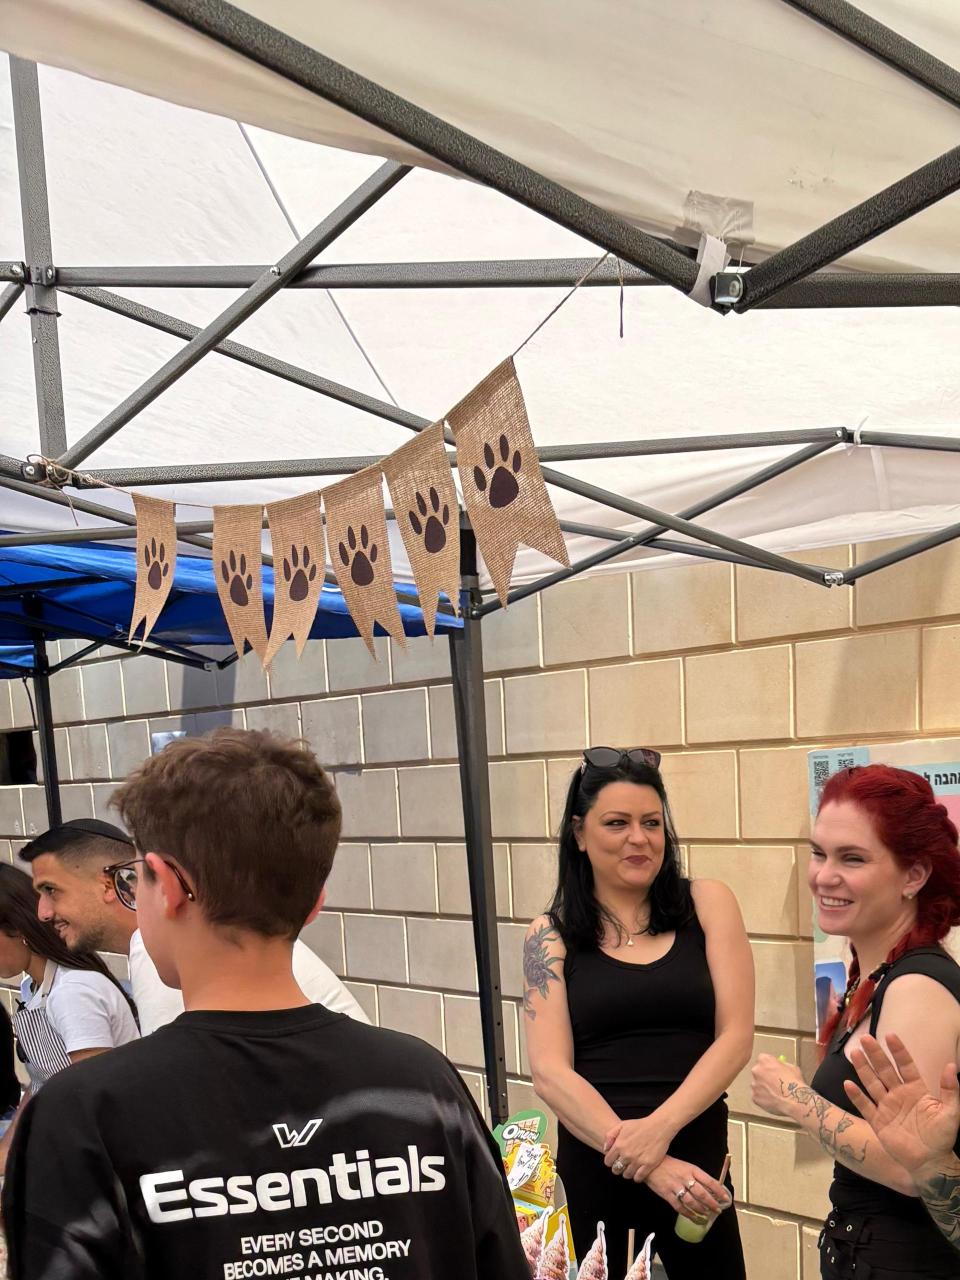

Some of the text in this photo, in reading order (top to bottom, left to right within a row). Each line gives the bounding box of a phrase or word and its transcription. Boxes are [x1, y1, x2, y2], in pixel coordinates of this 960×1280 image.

[139, 1144, 446, 1224] Essentials
[241, 1220, 384, 1255] EVERY SECOND
[308, 1250, 323, 1269] A
[326, 1239, 412, 1266] MEMORY
